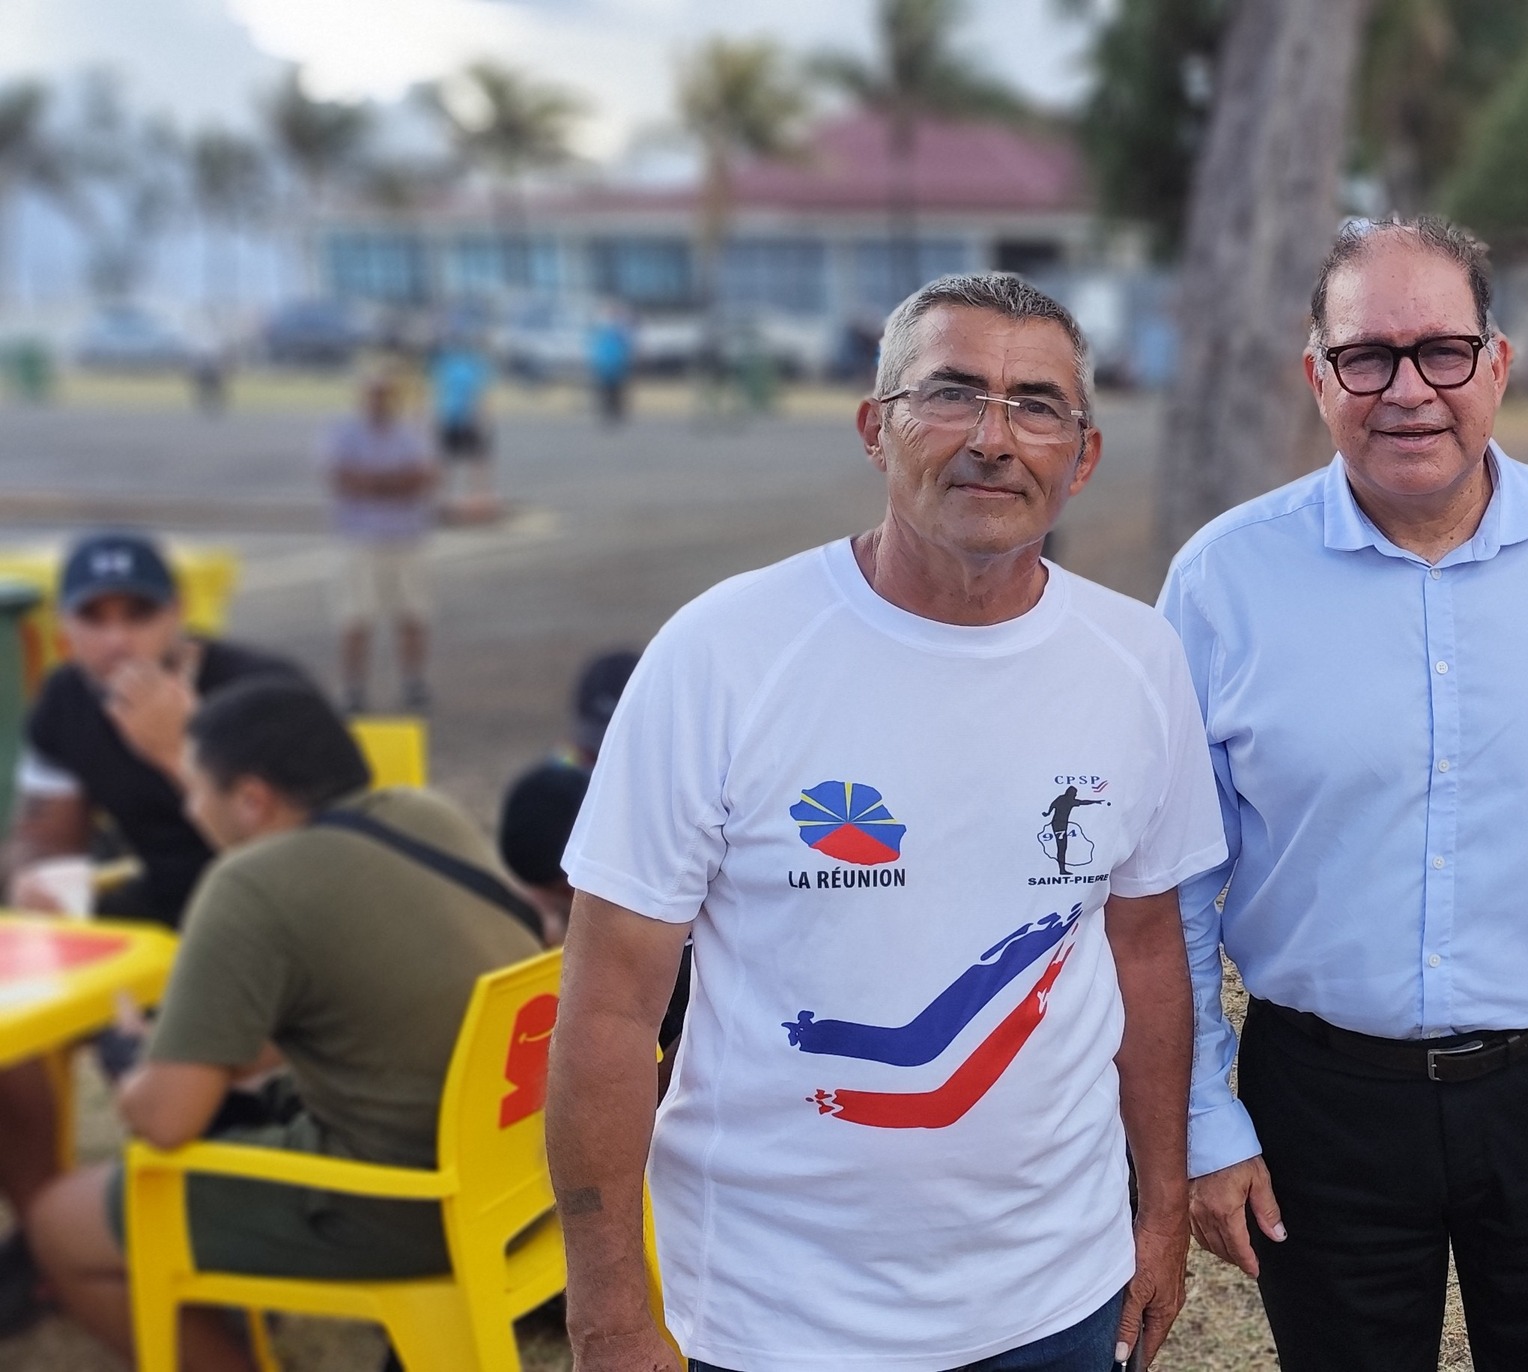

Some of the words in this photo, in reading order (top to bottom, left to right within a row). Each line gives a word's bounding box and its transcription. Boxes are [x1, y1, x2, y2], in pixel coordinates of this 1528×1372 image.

[1054, 775, 1101, 785] CPSP
[1042, 829, 1077, 842] 974
[788, 870, 811, 889] LA
[817, 866, 906, 889] RÉUNION
